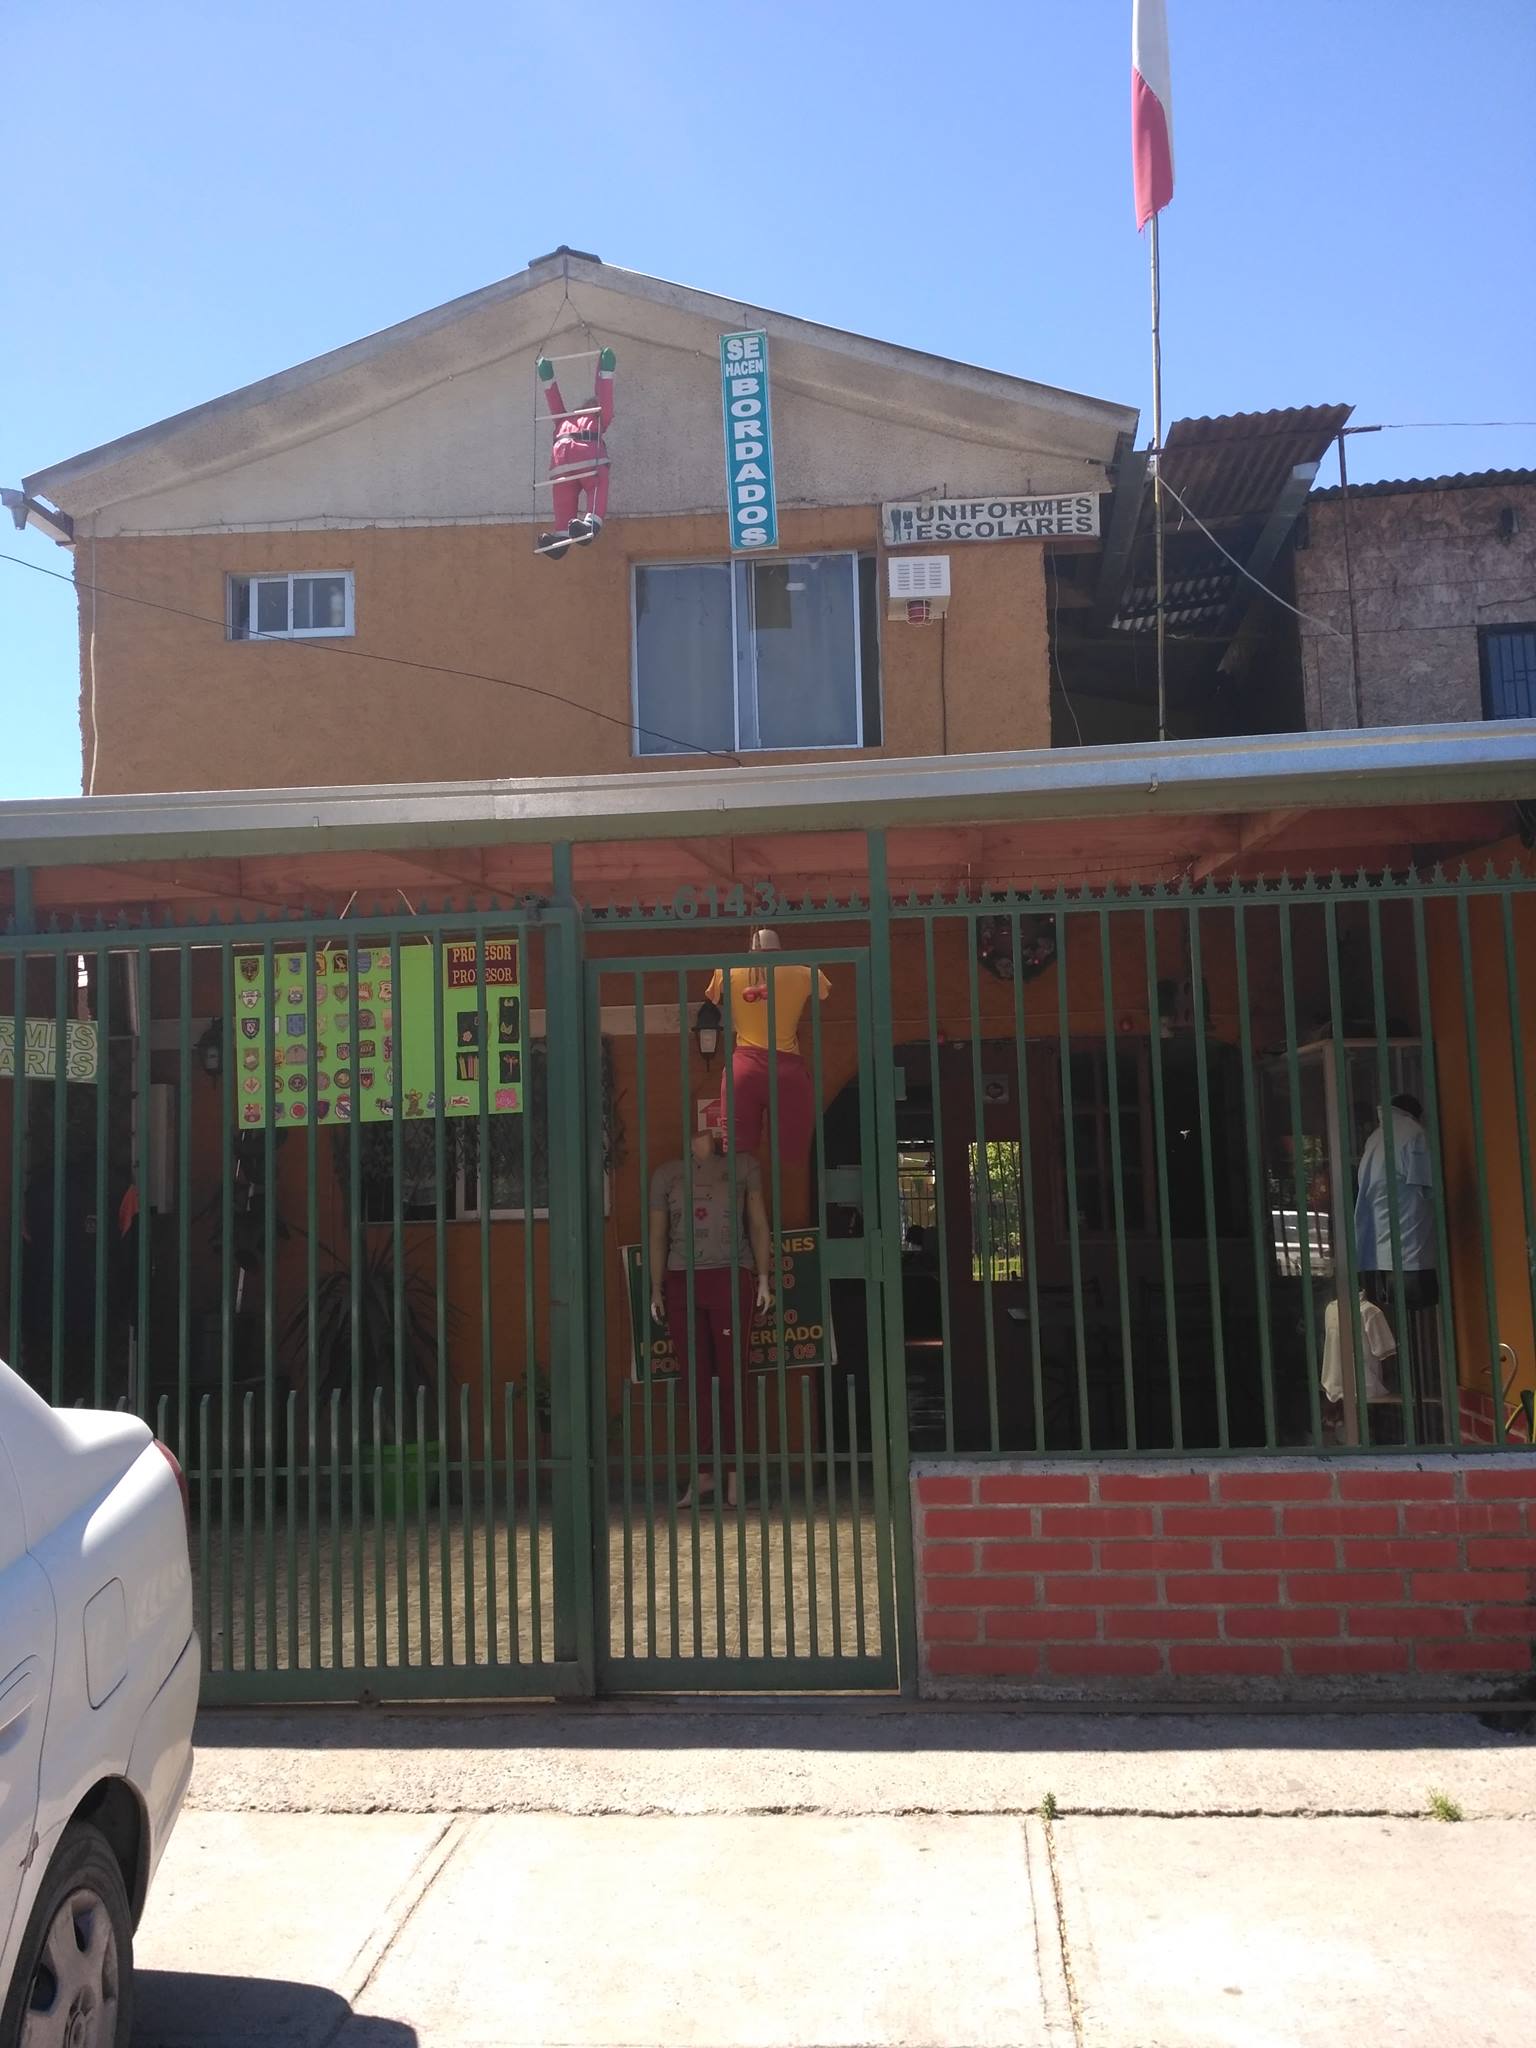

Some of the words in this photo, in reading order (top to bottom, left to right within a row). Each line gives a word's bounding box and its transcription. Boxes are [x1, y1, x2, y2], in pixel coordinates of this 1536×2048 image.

[727, 337, 760, 361] SE
[725, 359, 763, 377] HACEN
[731, 378, 768, 546] BORDADOS
[916, 498, 1093, 522] UNIFORMES
[916, 517, 1093, 540] ESCOLARES
[672, 882, 777, 919] 6143
[453, 945, 512, 963] PROESOR
[453, 967, 513, 985] PROESOR
